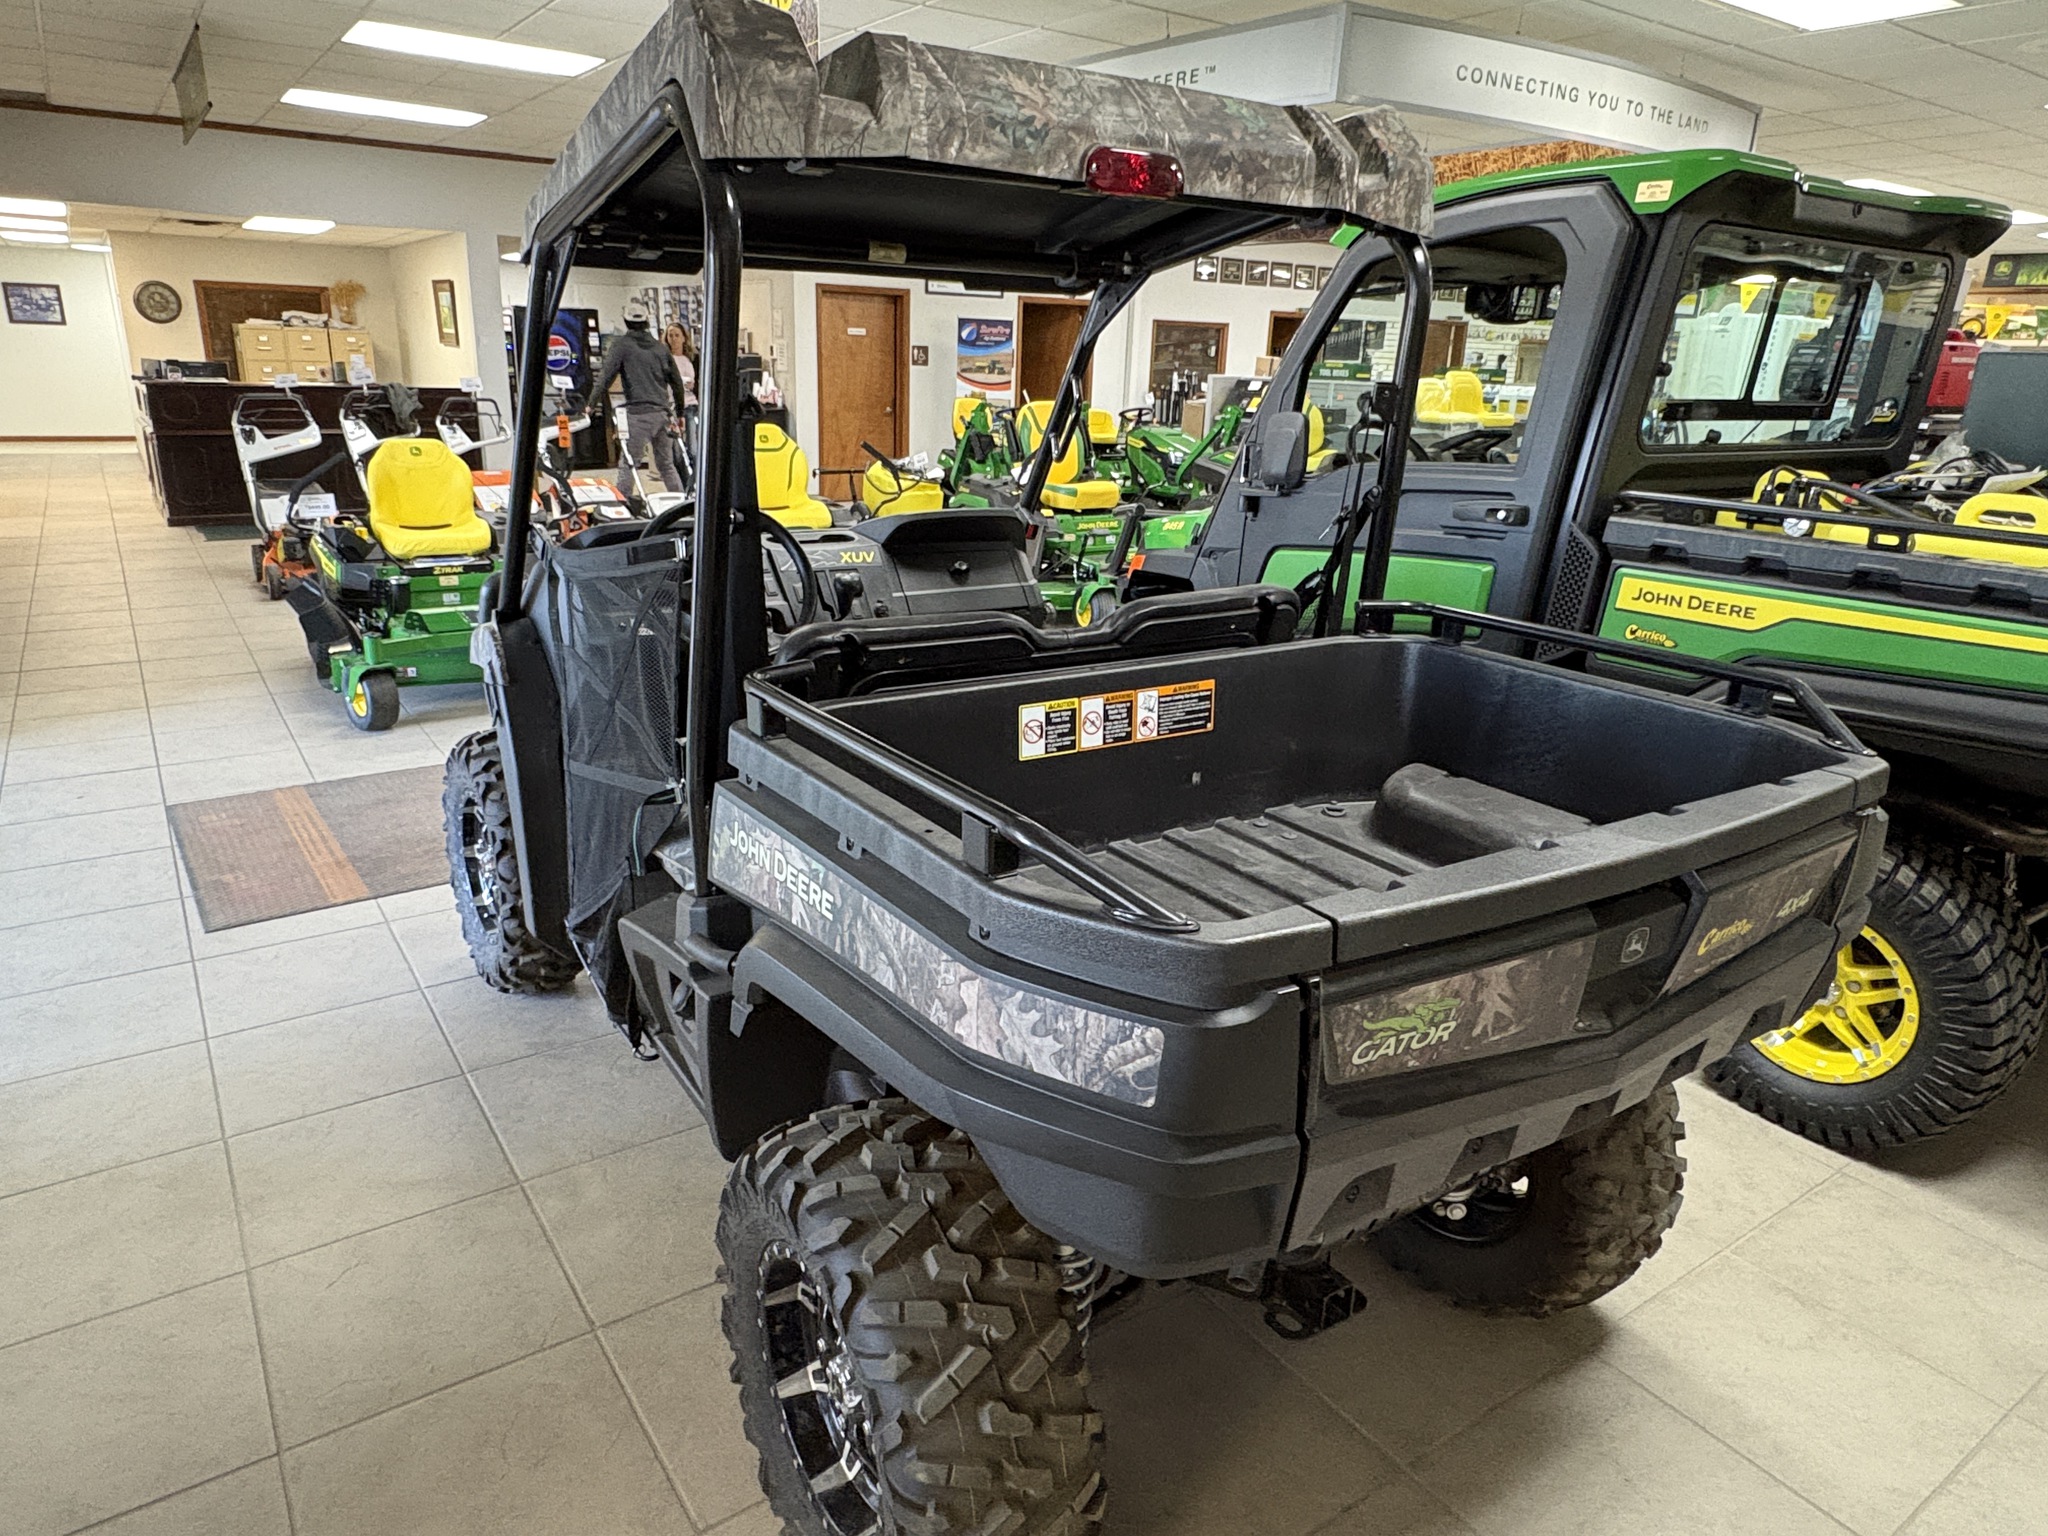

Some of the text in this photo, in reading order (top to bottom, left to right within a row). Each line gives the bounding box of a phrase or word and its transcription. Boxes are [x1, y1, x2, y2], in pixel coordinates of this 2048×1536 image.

[1456, 64, 1710, 135] CONNECTING YOU TO THE LAND
[839, 551, 875, 564] XUV
[1631, 587, 1758, 620] JOHN DEERE
[1624, 623, 1667, 642] Carrico
[729, 821, 834, 921] JOHN DEERE
[1351, 1020, 1458, 1066] GATOR
